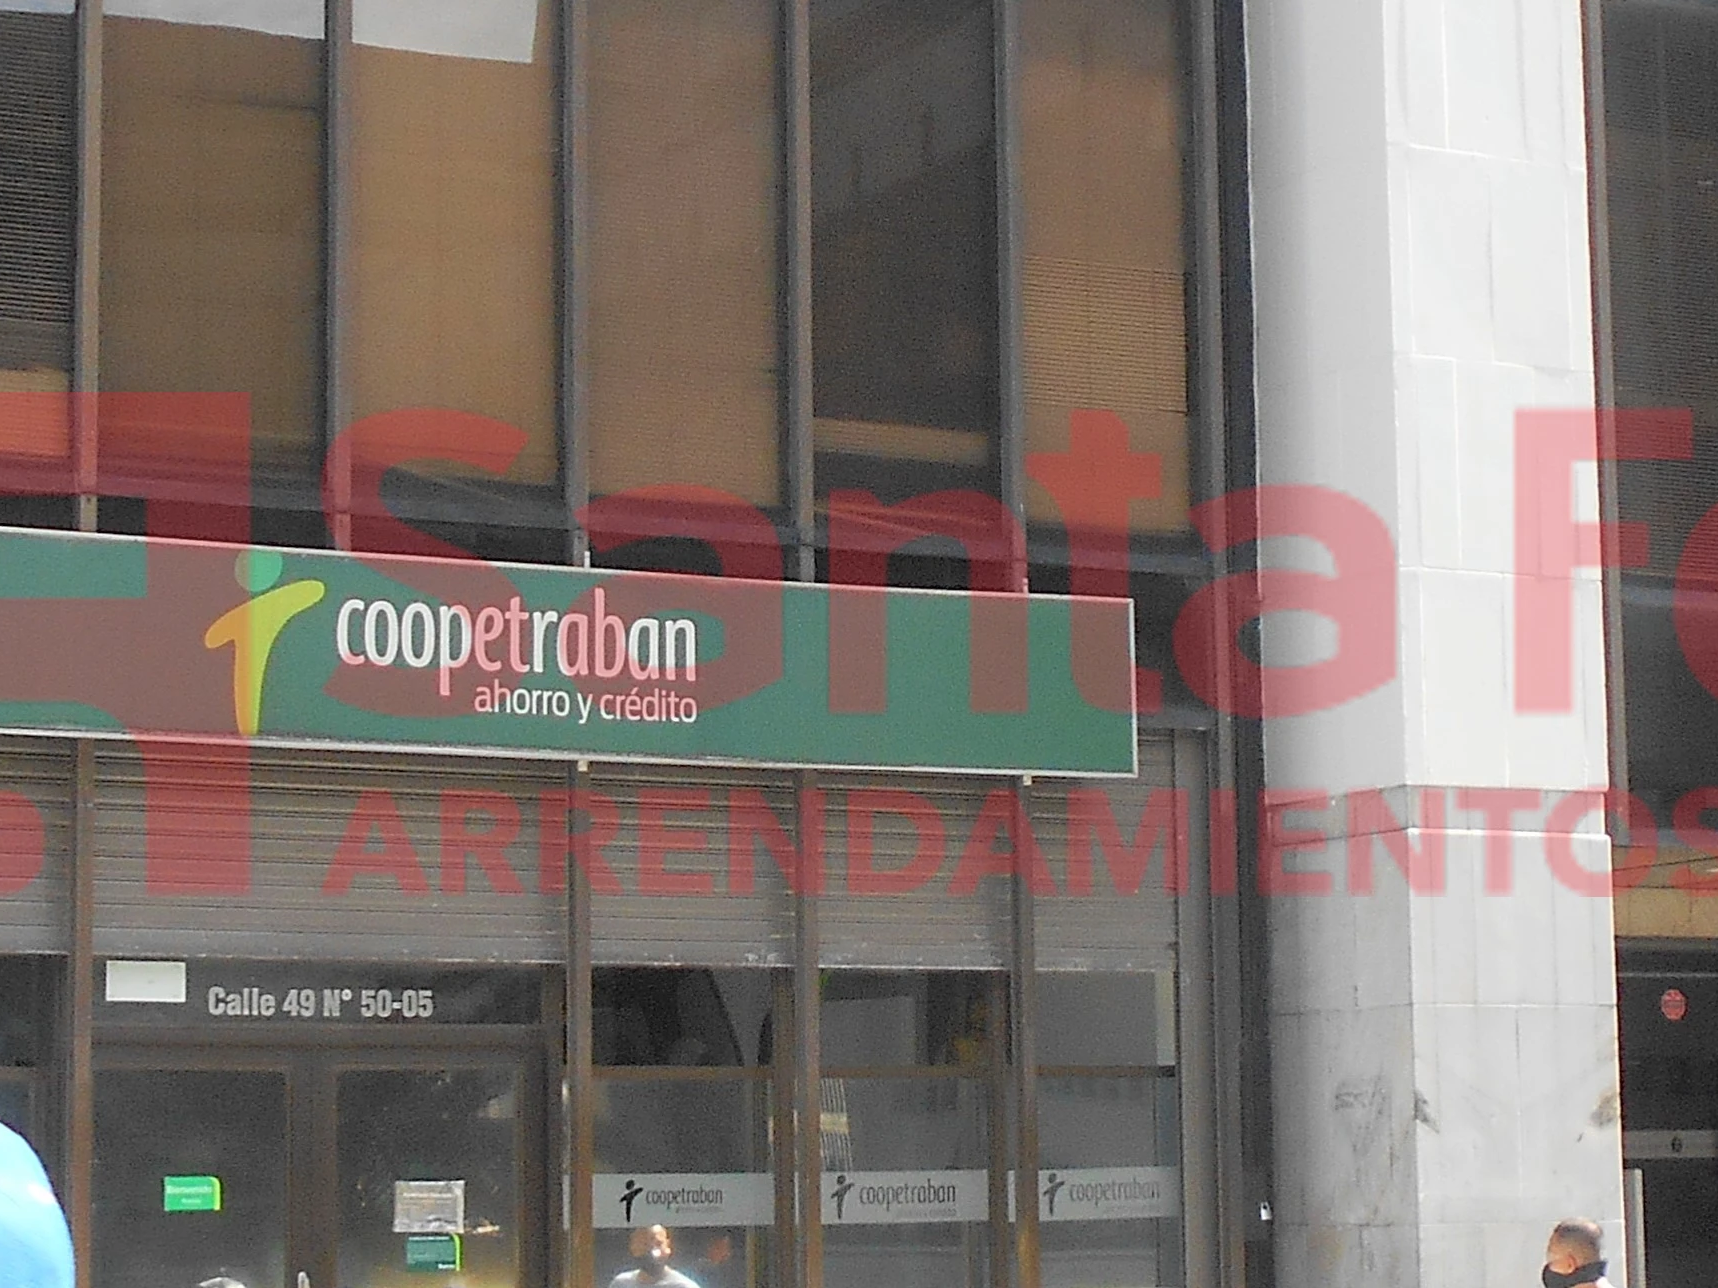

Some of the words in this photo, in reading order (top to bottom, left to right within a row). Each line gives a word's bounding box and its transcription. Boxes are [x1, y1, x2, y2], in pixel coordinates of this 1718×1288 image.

[336, 586, 697, 697] coopetraban
[473, 679, 571, 717] ahorro
[575, 692, 594, 724] y
[599, 687, 698, 724] crédito
[208, 985, 276, 1016] Calle
[282, 988, 316, 1017] 49
[360, 989, 434, 1018] 50-05
[645, 1184, 724, 1210] coopetraban
[858, 1177, 956, 1212] coopetraban
[1068, 1176, 1161, 1207] coopetraban
